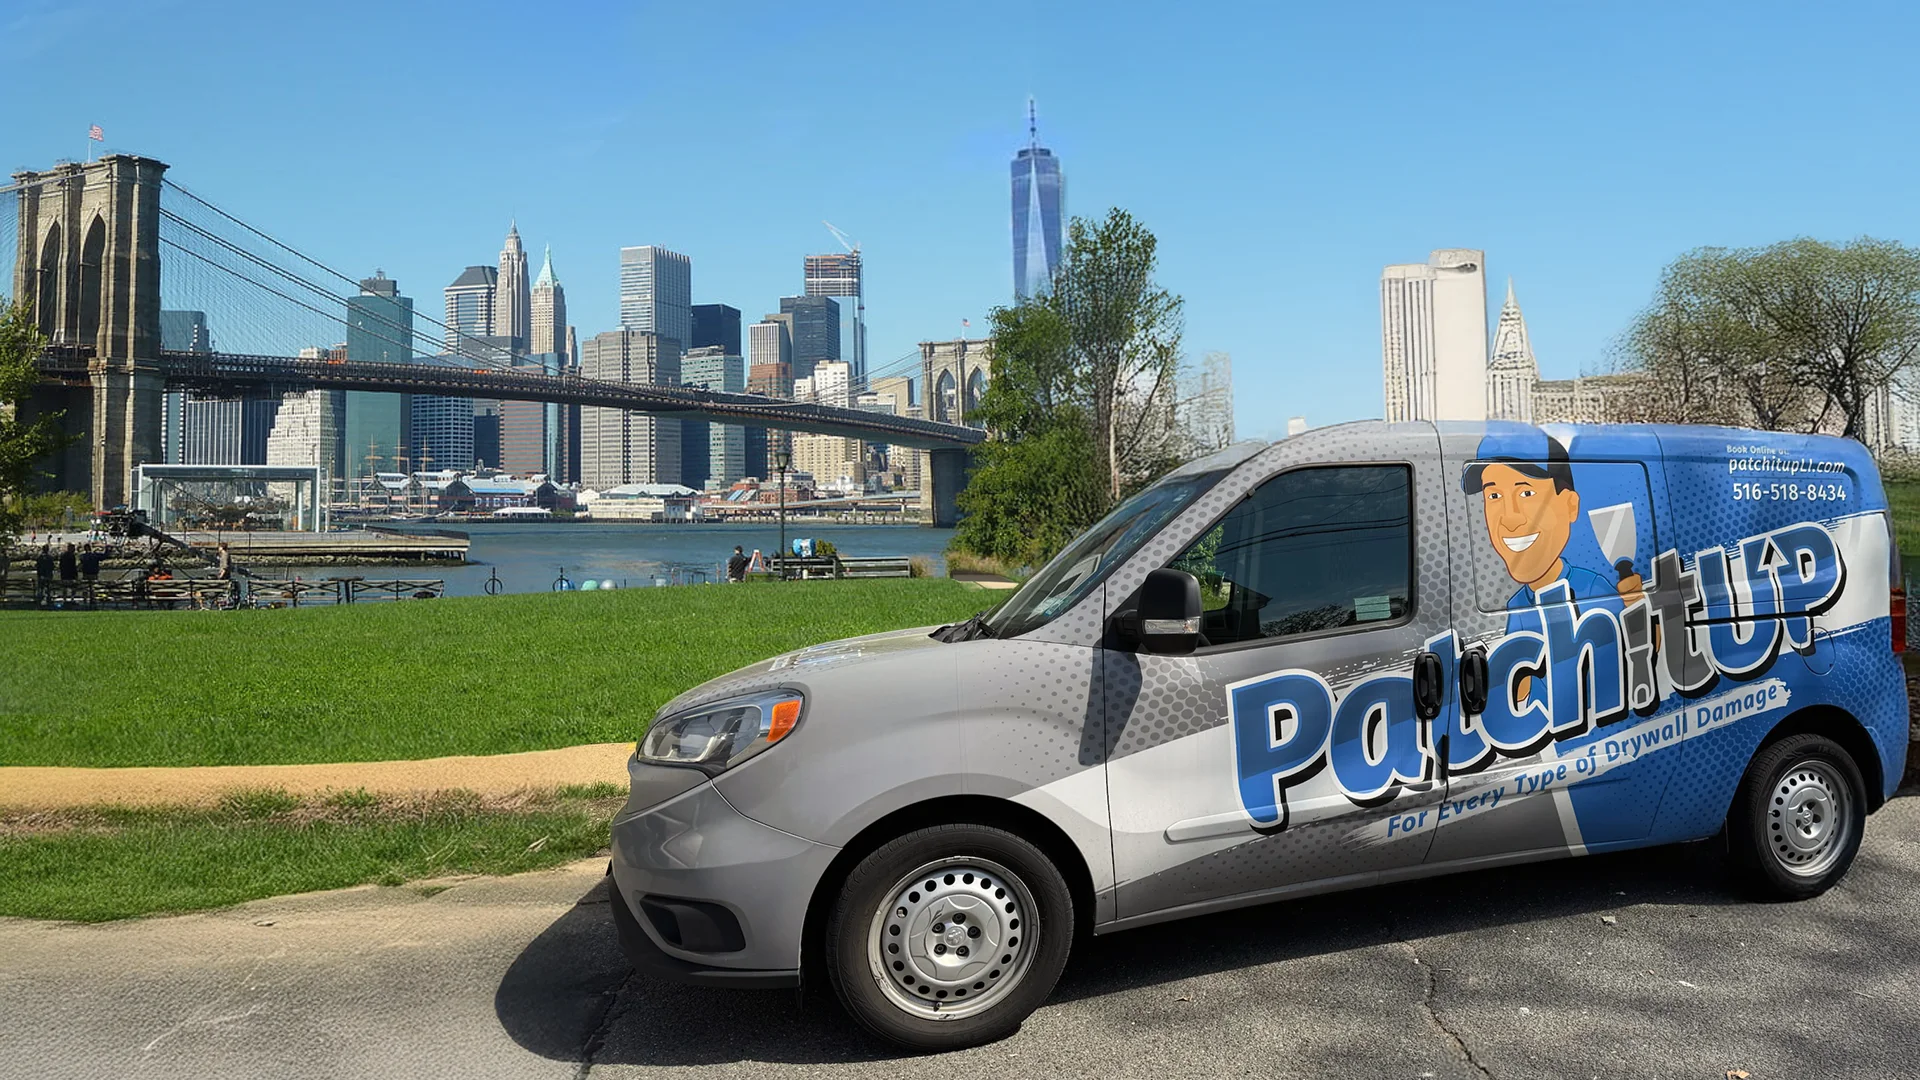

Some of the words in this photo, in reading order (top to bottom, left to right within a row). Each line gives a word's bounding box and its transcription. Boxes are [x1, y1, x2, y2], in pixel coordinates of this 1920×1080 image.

[1726, 445, 1747, 454] Book
[1750, 445, 1776, 454] Online
[1733, 483, 1846, 501] 516-518-8434
[1387, 811, 1427, 838] For
[1439, 786, 1505, 822] Every
[1515, 763, 1567, 796] Type
[1576, 745, 1598, 775] of
[1605, 711, 1688, 762] Drywall
[1697, 684, 1777, 730] Damage
